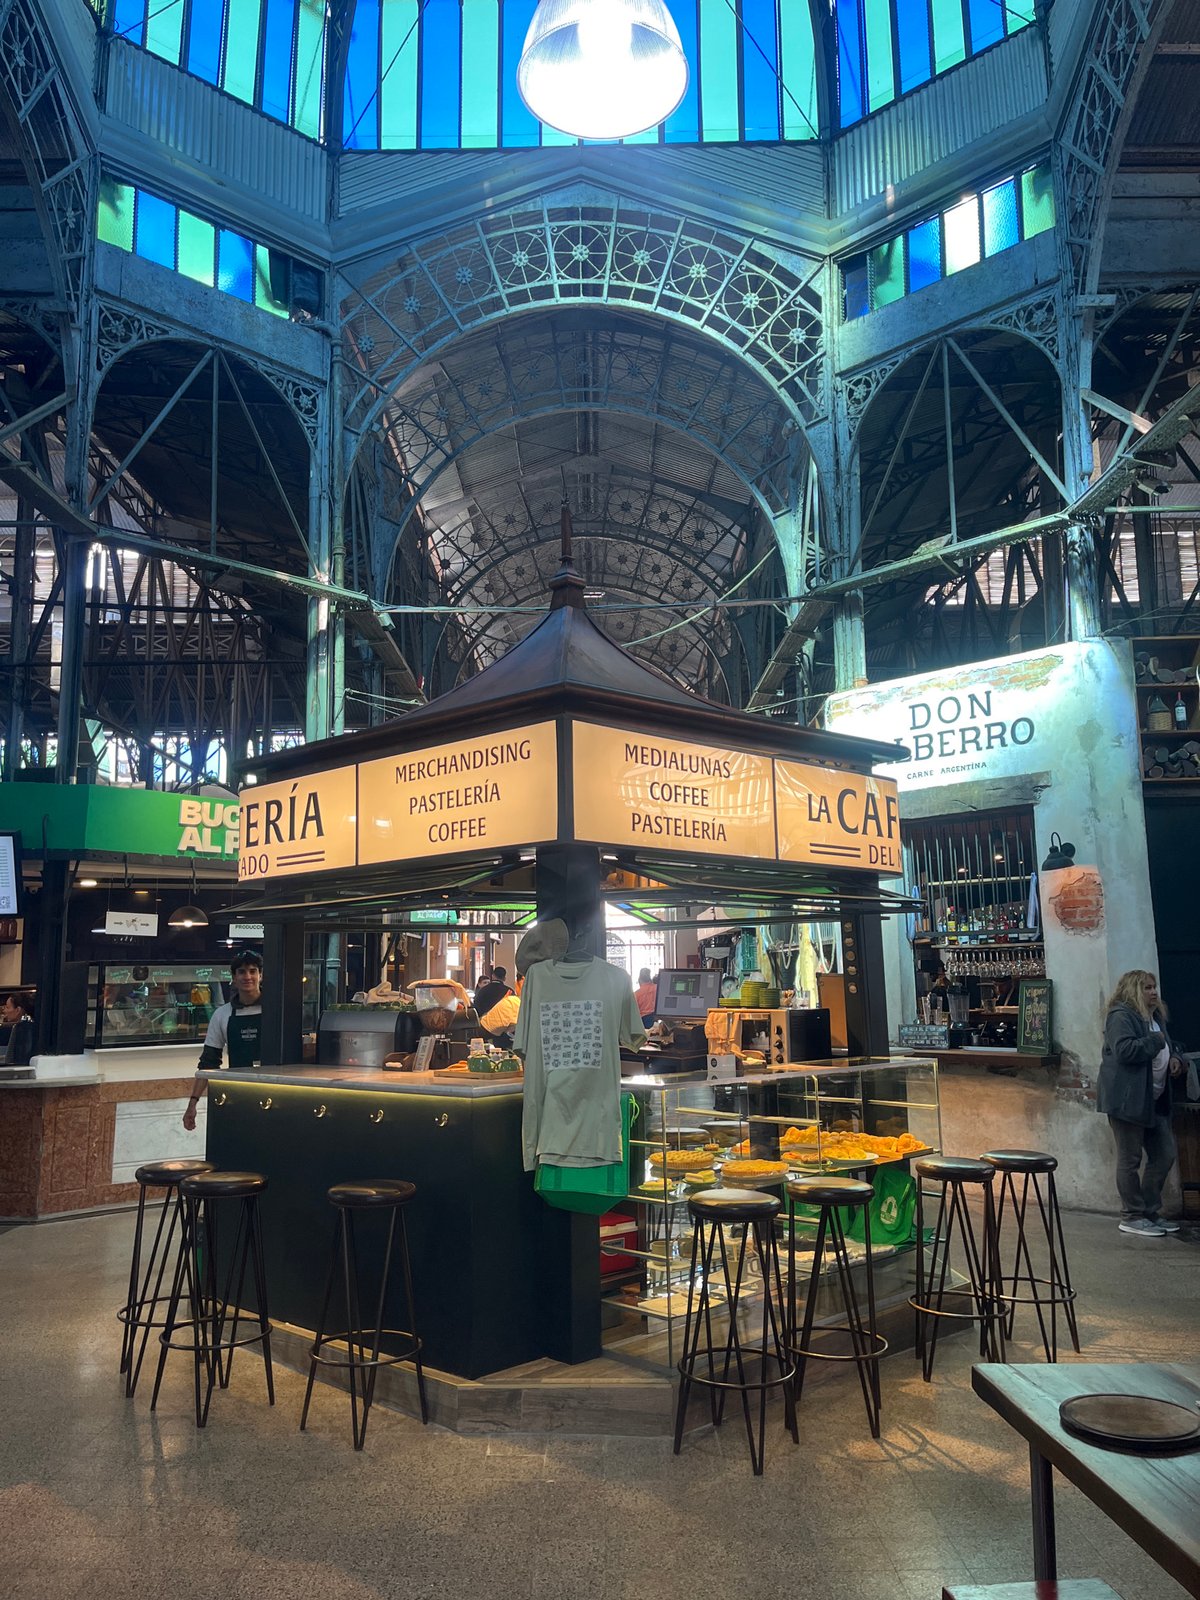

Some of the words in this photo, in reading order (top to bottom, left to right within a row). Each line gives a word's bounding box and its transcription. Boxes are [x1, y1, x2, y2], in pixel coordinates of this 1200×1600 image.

[909, 690, 992, 731] DON
[395, 740, 531, 784] MERCHANDISING
[625, 743, 731, 779] MEDIALUNAS
[906, 769, 935, 780] CARNE
[409, 779, 501, 815] PASTELERÍA
[650, 781, 709, 807] COFFEE
[807, 793, 833, 824] LA
[240, 783, 325, 848] ERÍA
[428, 817, 487, 843] COFFEE
[631, 812, 728, 842] PASTELERÍA
[868, 844, 895, 867] DEL
